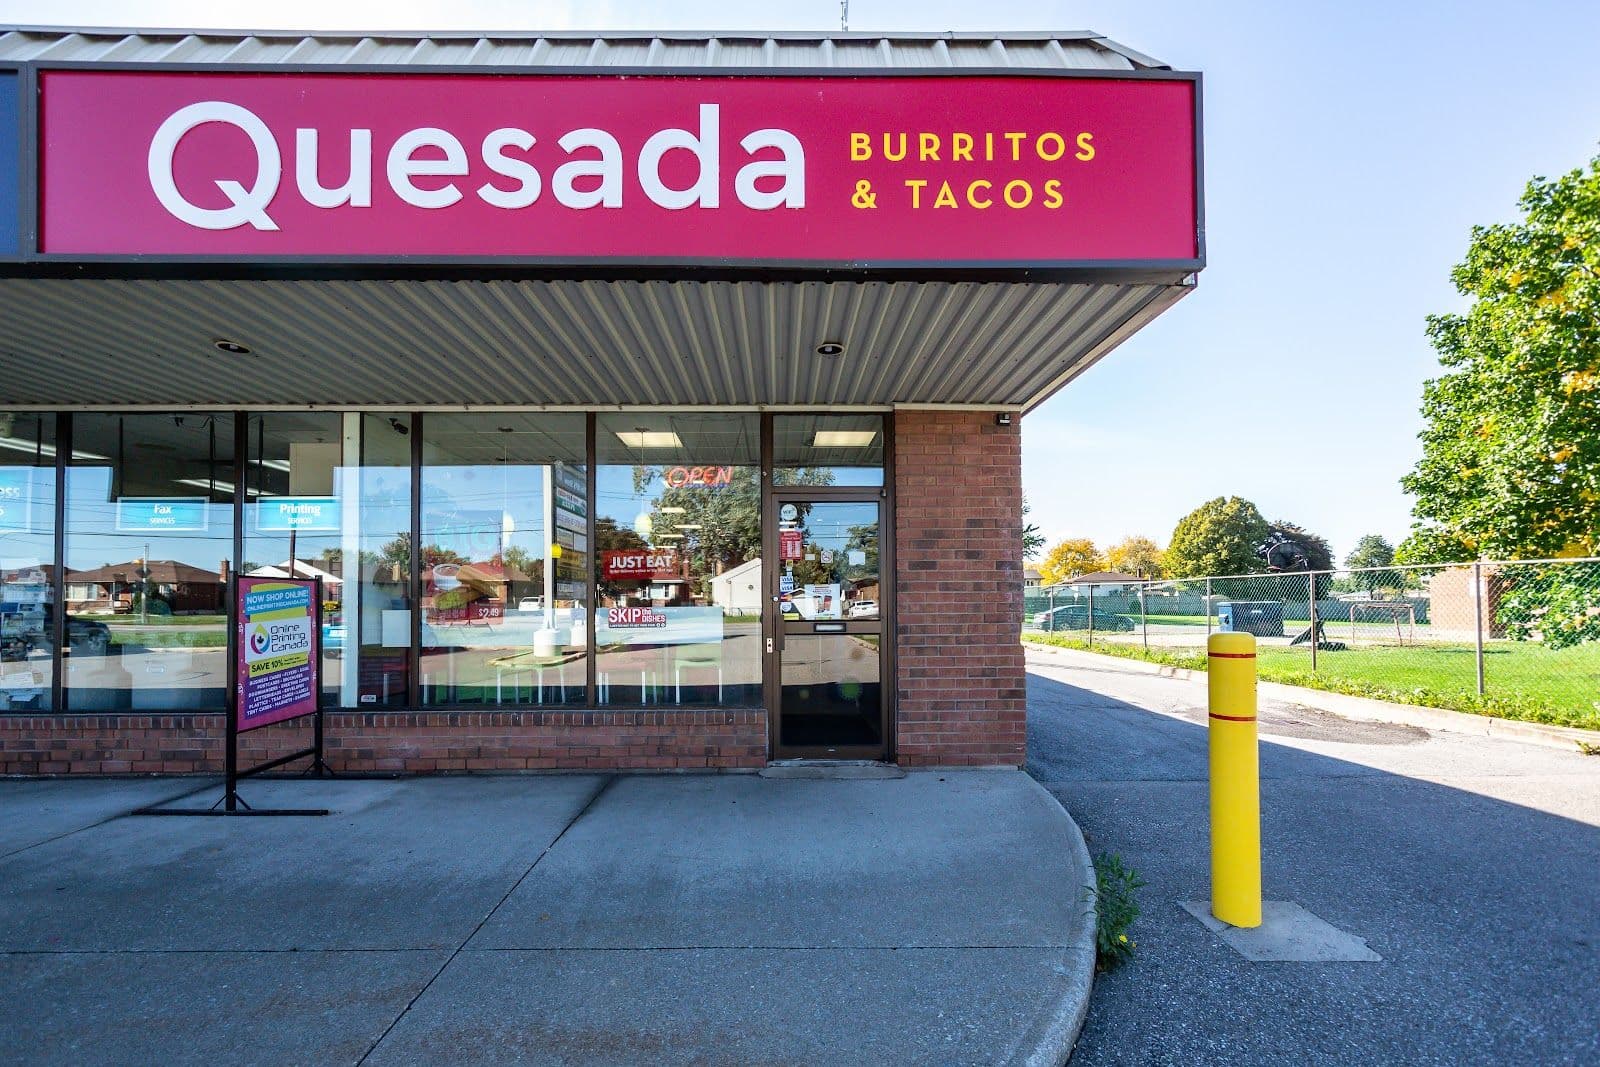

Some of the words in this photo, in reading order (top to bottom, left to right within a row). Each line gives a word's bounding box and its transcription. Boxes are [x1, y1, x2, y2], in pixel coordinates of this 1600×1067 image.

[850, 132, 1096, 162] BURRITOS
[148, 101, 806, 231] Quesada
[851, 180, 877, 208] &
[905, 179, 1064, 209] TACOS
[668, 466, 733, 487] OPEN
[154, 503, 172, 514] Fax
[280, 503, 320, 516] Printing
[609, 556, 646, 569] JUST
[647, 555, 673, 568] EAT
[246, 595, 265, 604] NOW
[266, 592, 284, 602] SHOP
[478, 607, 499, 618] $2.49
[608, 608, 641, 622] SKIP
[642, 614, 666, 623] DISHES
[270, 624, 300, 634] Online
[271, 633, 306, 643] Printing
[271, 640, 308, 652] Canada
[251, 662, 270, 673] SAVE
